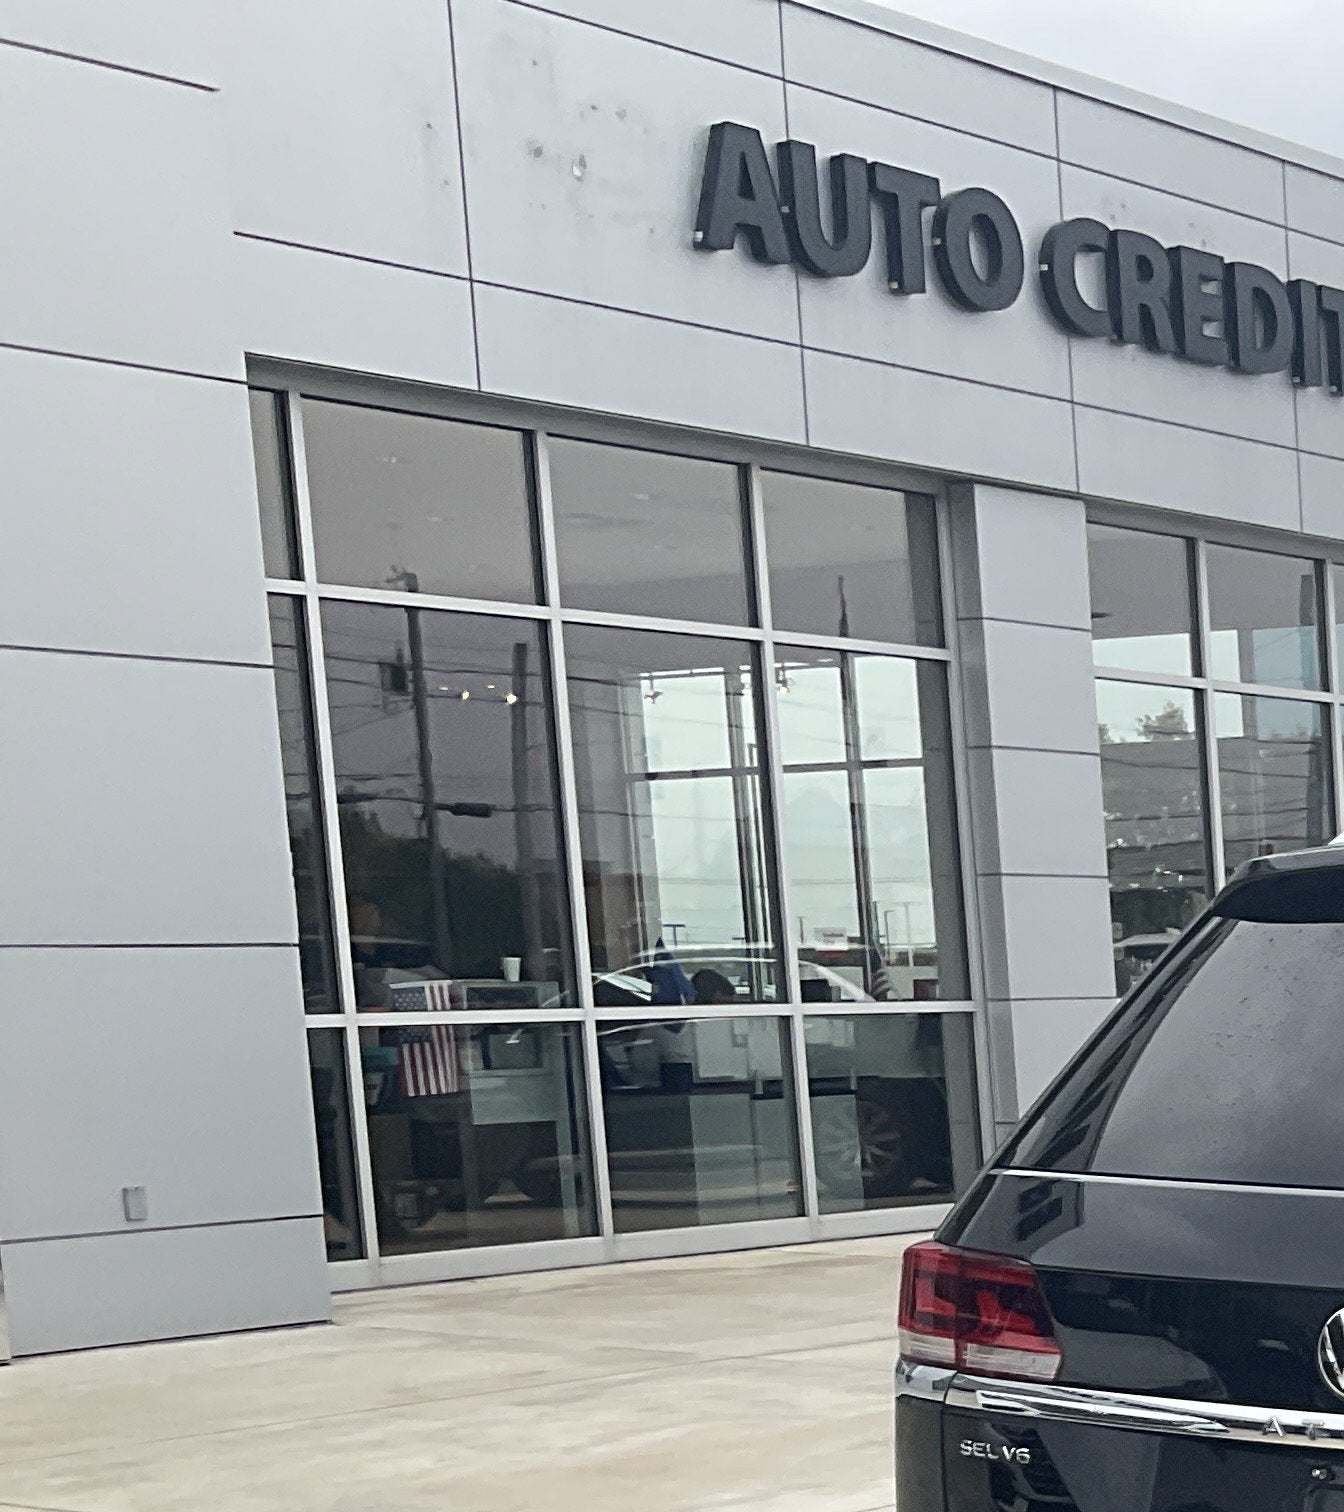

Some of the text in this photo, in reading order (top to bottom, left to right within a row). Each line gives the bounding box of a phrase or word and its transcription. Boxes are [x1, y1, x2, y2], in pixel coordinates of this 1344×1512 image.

[693, 121, 1024, 313] AUTO
[959, 1439, 1031, 1465] SEL V6
